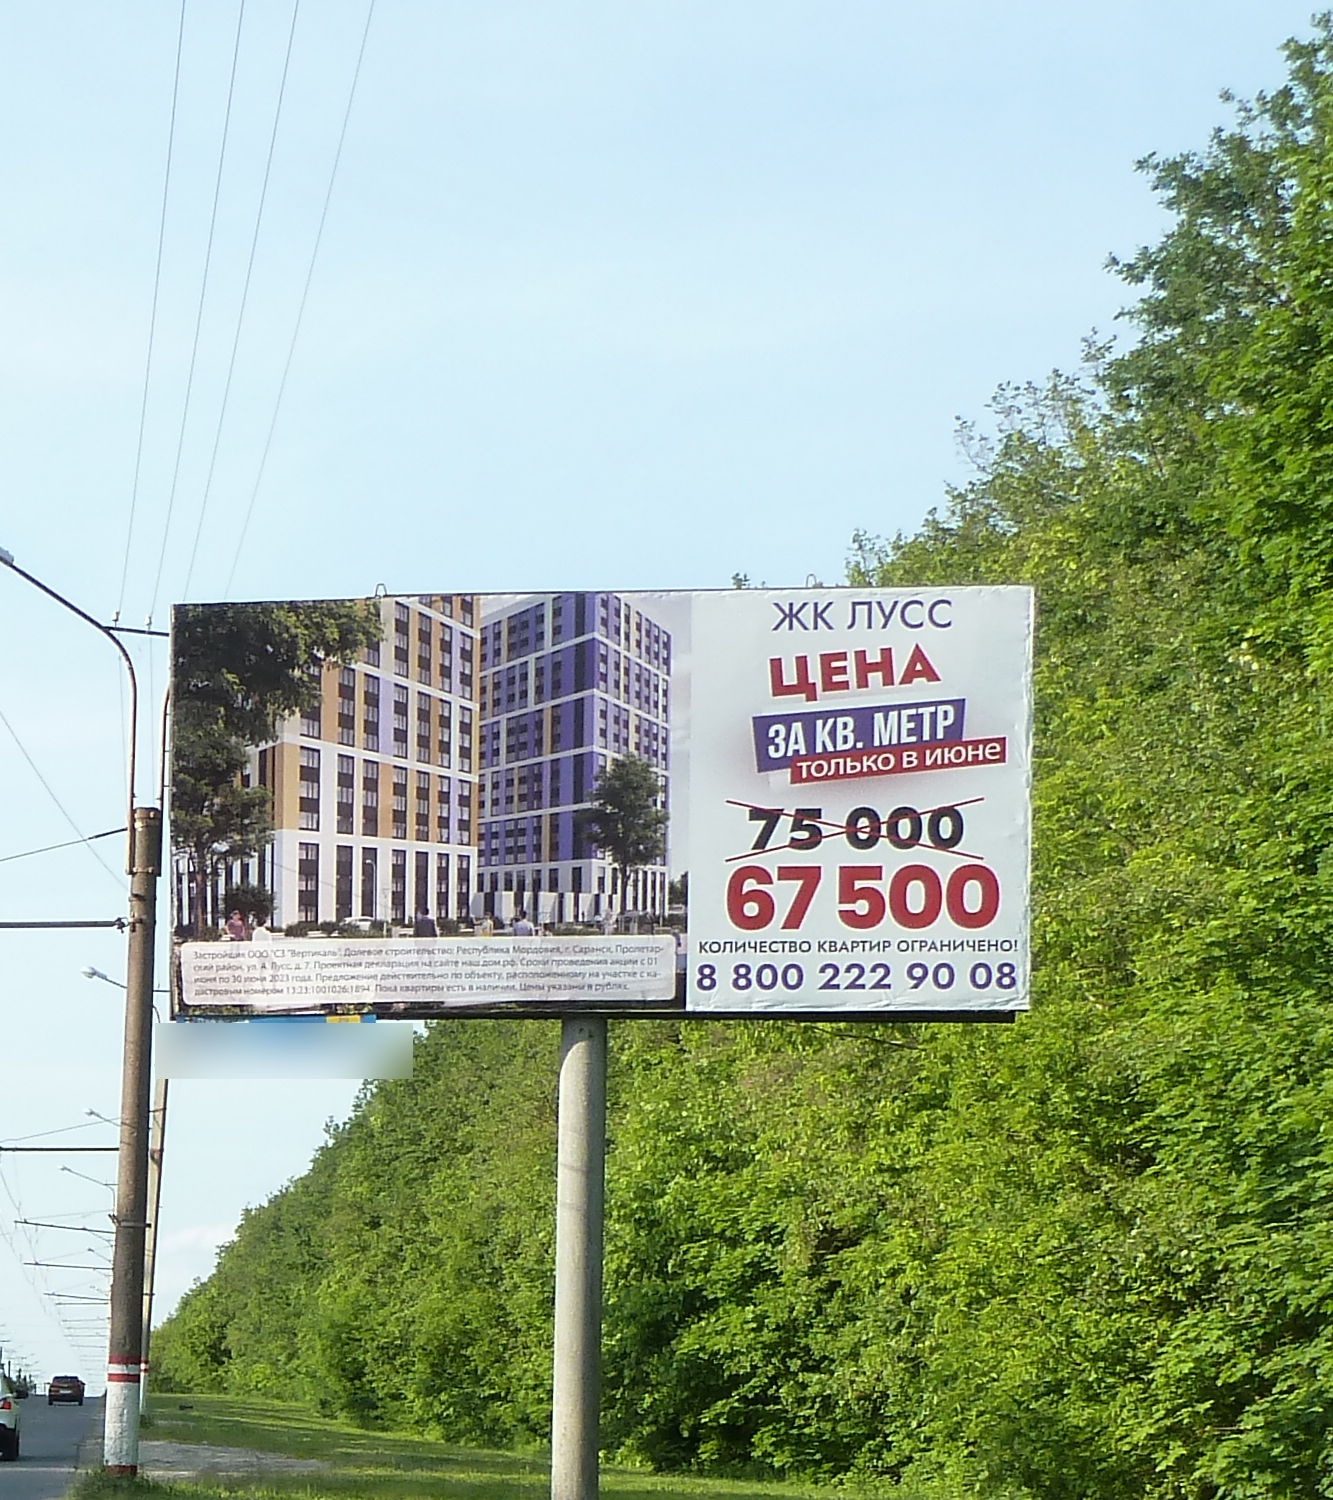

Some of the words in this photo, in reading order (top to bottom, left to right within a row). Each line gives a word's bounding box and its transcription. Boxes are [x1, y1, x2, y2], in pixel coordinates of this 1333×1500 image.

[772, 601, 834, 631] ЖК
[847, 599, 953, 630] ЛУСС
[769, 643, 941, 702] ЦЕНА
[768, 722, 806, 758] ЗА
[815, 716, 863, 754] КВ.
[873, 705, 954, 746] МЕТР
[748, 807, 823, 851] 75
[845, 806, 964, 850] 000
[727, 865, 822, 931] 67
[838, 864, 1000, 930] 500
[247, 950, 269, 958] ООО
[343, 948, 383, 957] Долевое
[456, 946, 510, 956] Республика
[699, 941, 811, 954] КОЛИЧЕСТВО
[817, 940, 891, 954] КВАРТИР
[897, 939, 1018, 952] ОГРАНИЧЕНО!
[313, 960, 363, 970] Проектная
[433, 959, 459, 968] сайте
[519, 958, 549, 968] Сроки
[551, 959, 608, 967] проведения
[315, 973, 377, 982] Предложение
[380, 972, 449, 981] действительно
[505, 971, 586, 981] расположенному
[601, 970, 637, 980] участке
[696, 964, 717, 990] 8
[731, 963, 804, 990] 800
[817, 962, 892, 990] 222
[906, 962, 956, 989] 90
[969, 962, 1017, 989] 08
[399, 984, 444, 994] квартиры
[447, 984, 466, 992] есть
